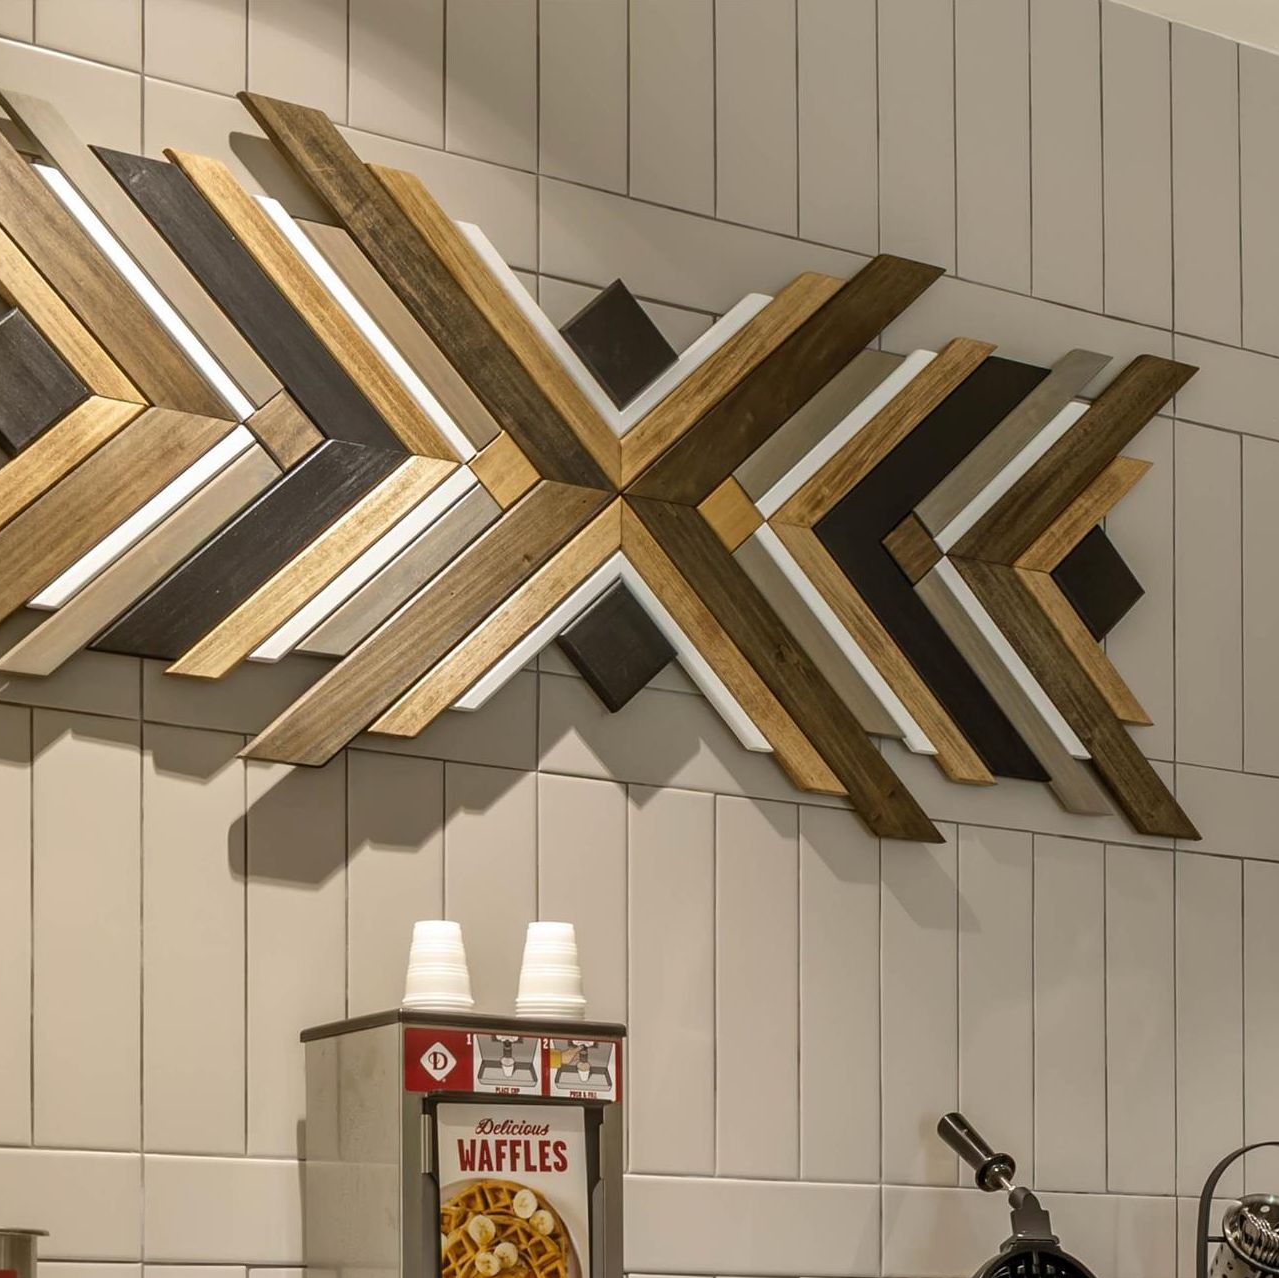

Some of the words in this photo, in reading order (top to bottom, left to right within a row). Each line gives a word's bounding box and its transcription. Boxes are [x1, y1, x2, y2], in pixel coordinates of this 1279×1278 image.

[466, 1034, 472, 1045] 1
[542, 1038, 549, 1049] 2
[428, 1051, 448, 1070] D
[475, 1118, 550, 1136] Delicious
[457, 1138, 568, 1173] WAFFLES
